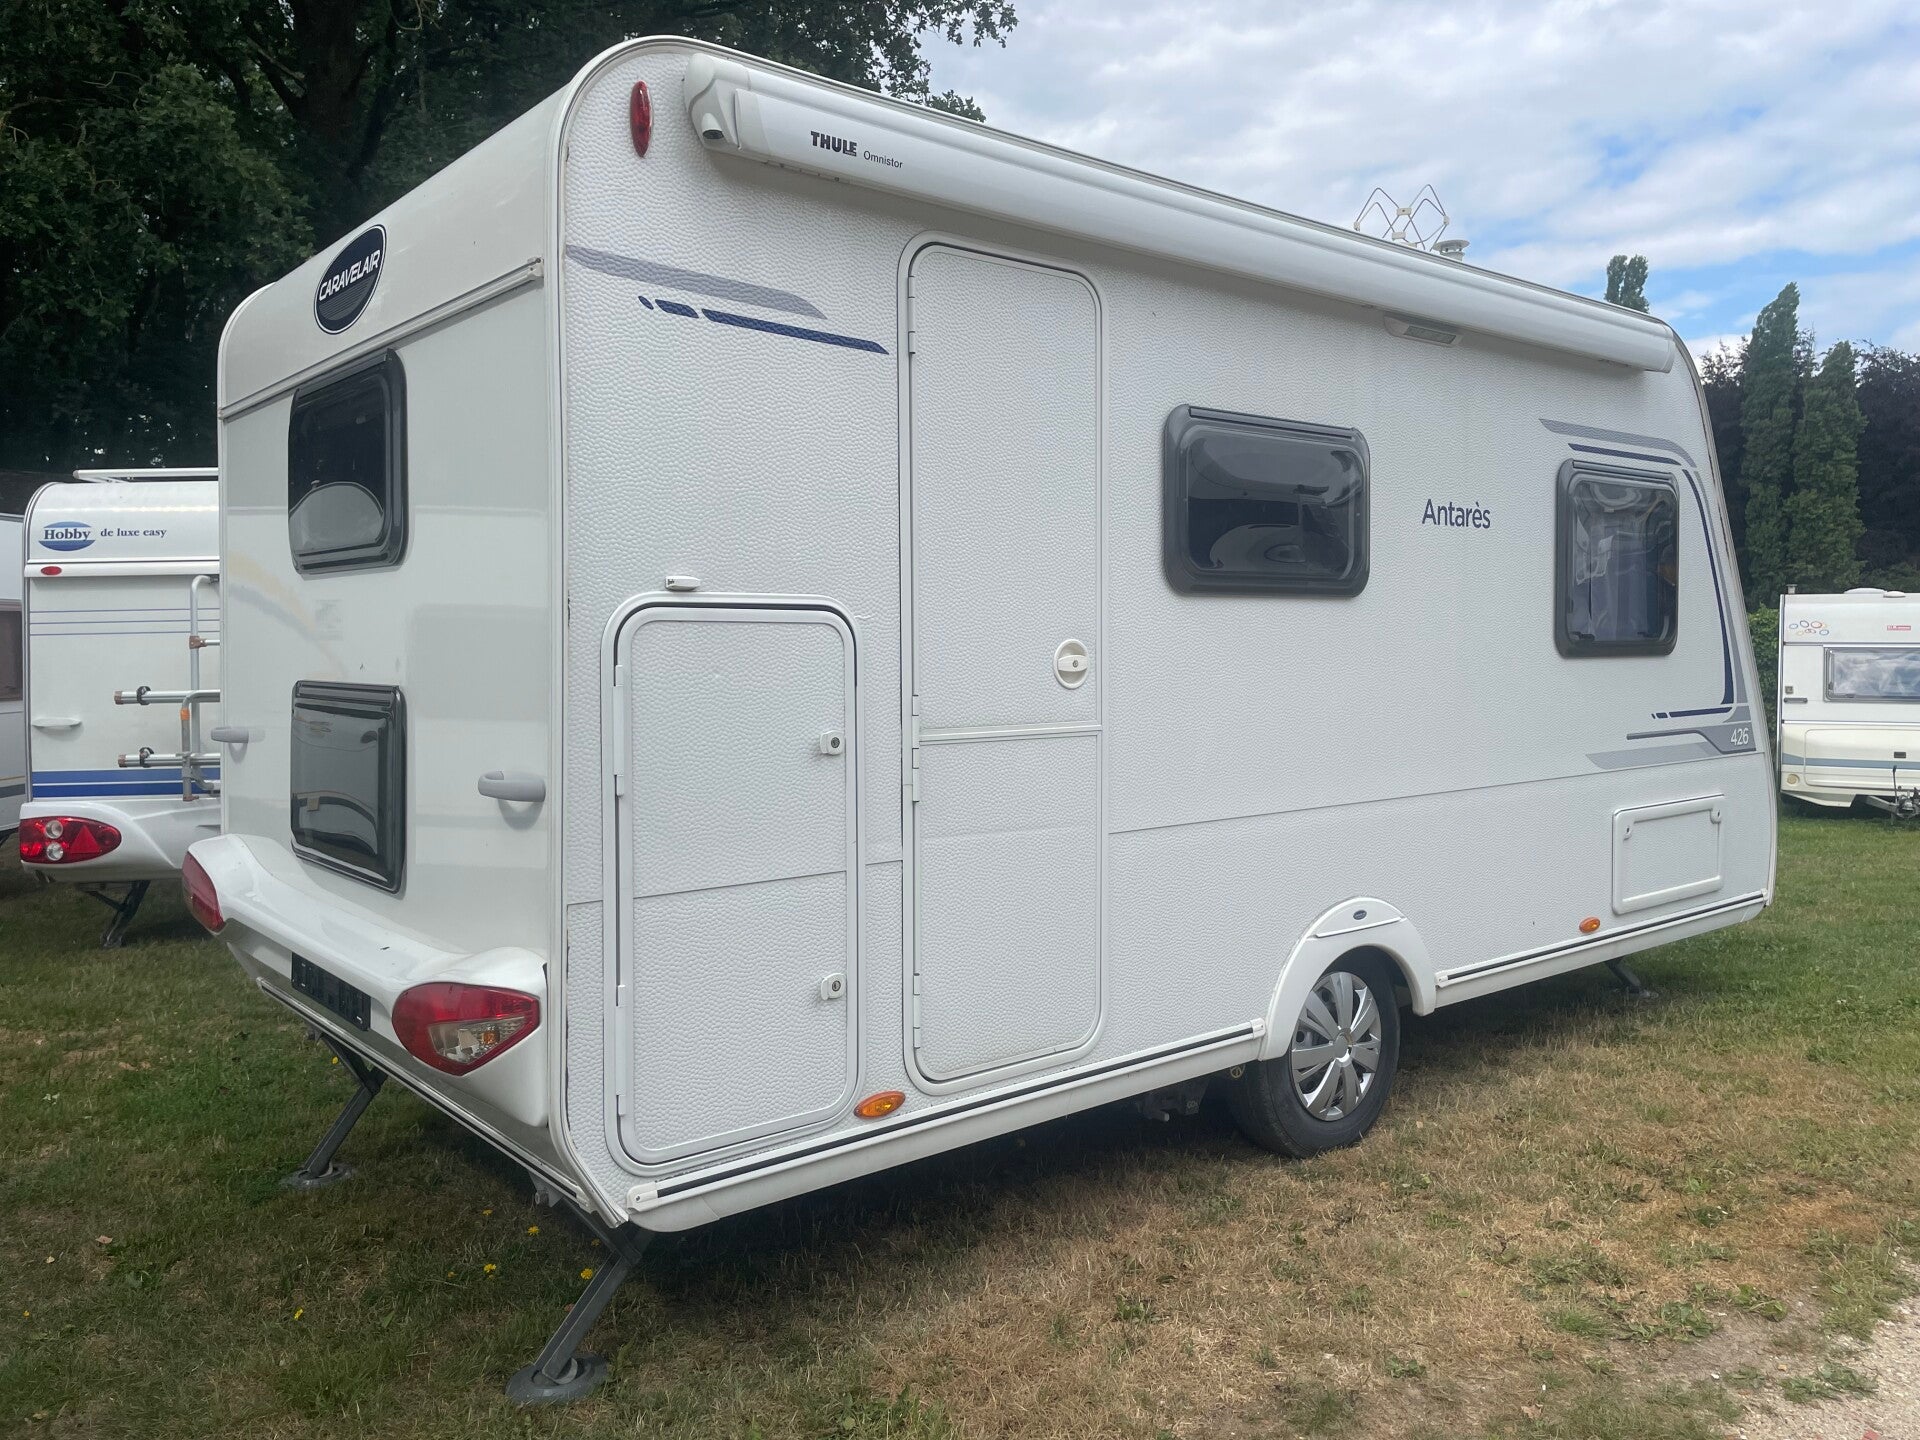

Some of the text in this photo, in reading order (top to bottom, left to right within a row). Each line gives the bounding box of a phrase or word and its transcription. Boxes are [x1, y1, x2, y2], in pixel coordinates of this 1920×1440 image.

[811, 130, 903, 168] THULE Omnistor
[319, 249, 381, 301] CARAVELAIR
[1421, 498, 1491, 529] Antarès
[44, 528, 167, 541] Hobby de luxe easy
[1730, 727, 1749, 746] 426
